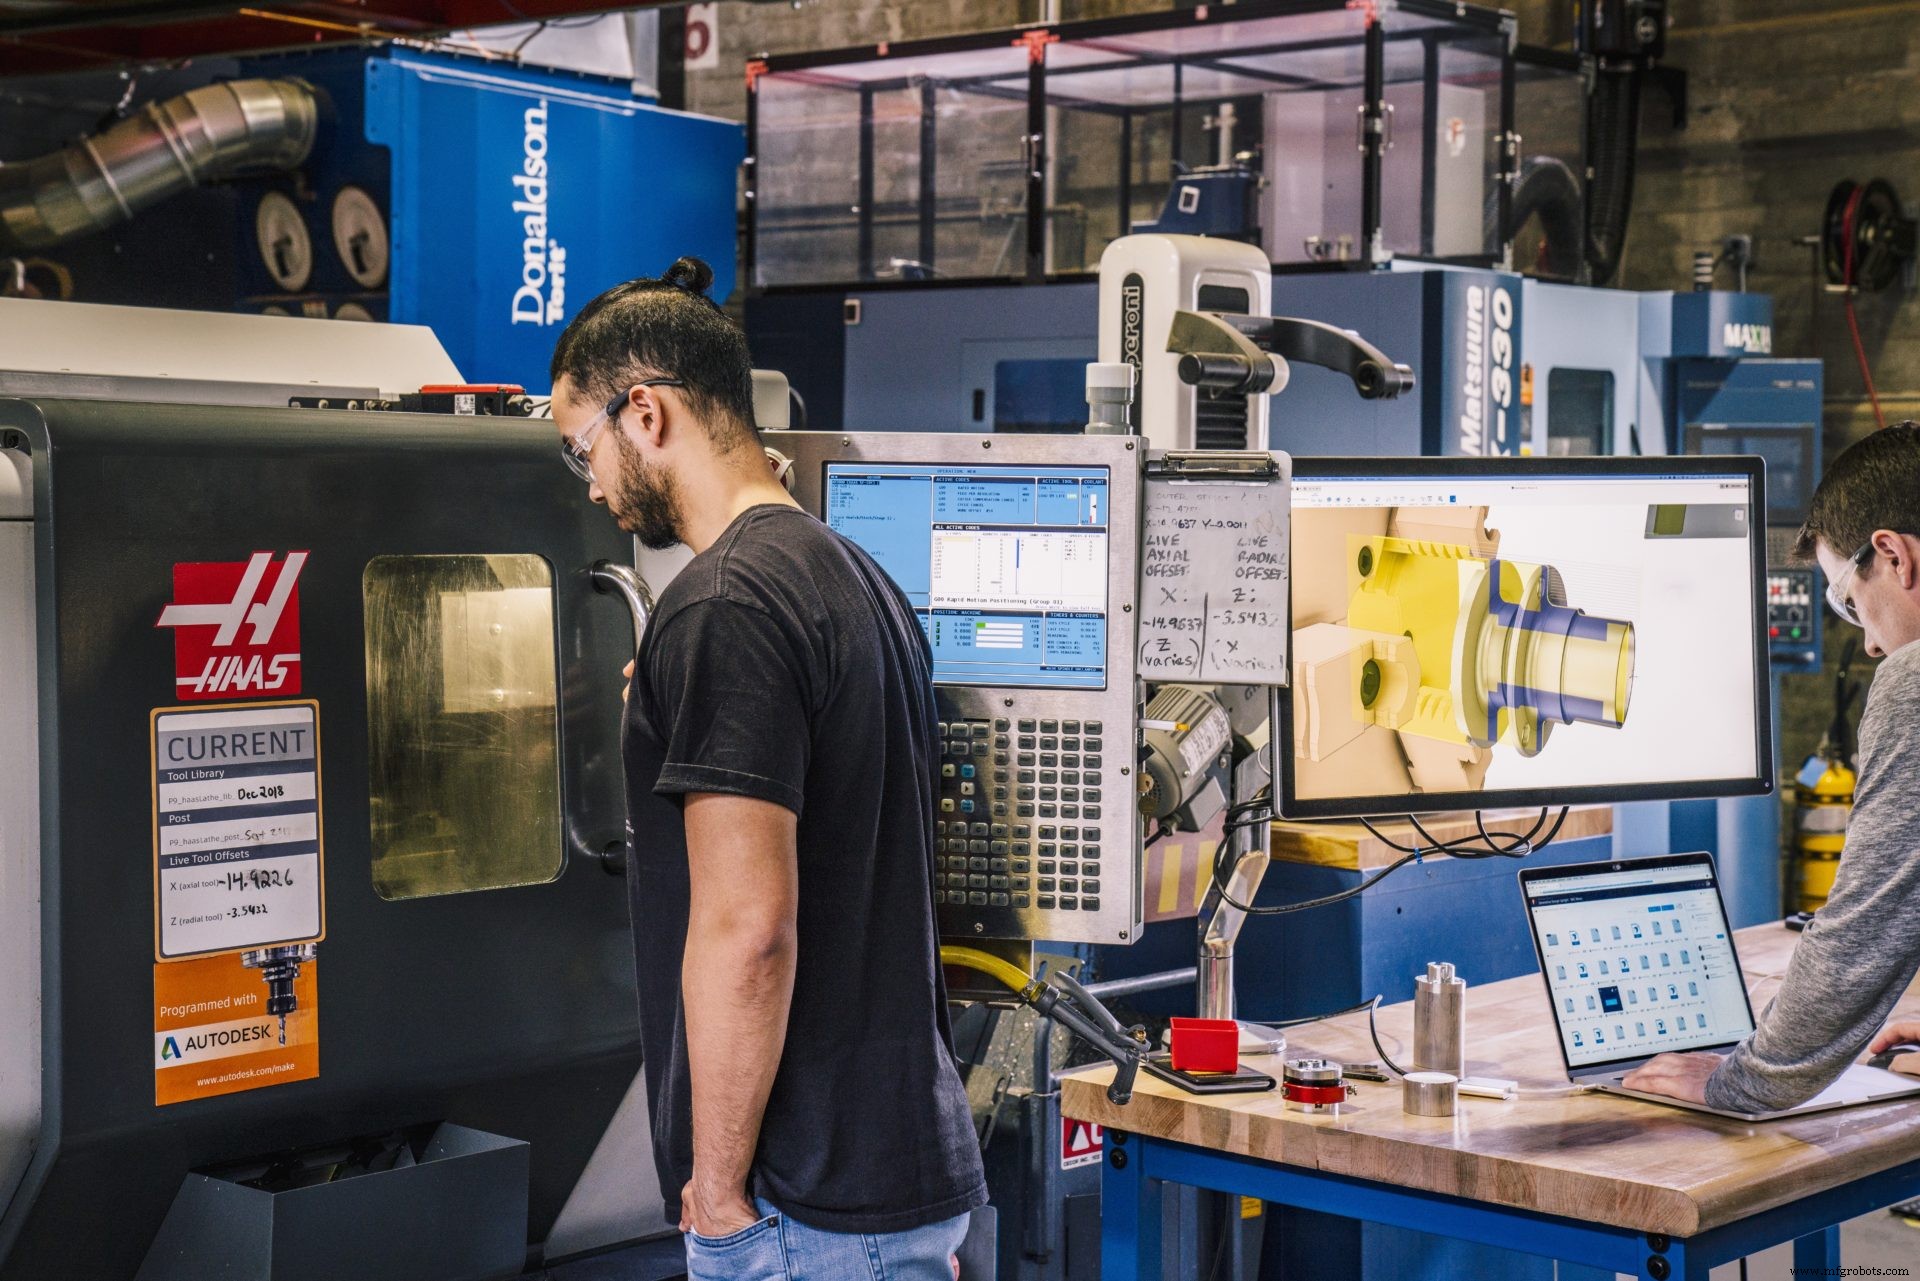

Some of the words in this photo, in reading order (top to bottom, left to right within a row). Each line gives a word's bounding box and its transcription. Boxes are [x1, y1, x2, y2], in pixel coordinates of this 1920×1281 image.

[1145, 534, 1180, 546] LIVE
[1146, 548, 1190, 562] AXIAL
[176, 653, 301, 693] HAAS
[167, 729, 306, 762] CURRENT
[167, 771, 188, 781] Tool
[191, 769, 225, 780] Library
[237, 788, 259, 801] Dec
[259, 785, 285, 798] 2018
[168, 813, 191, 824] Post
[169, 856, 190, 866] Live
[191, 854, 213, 864] Tool
[215, 850, 250, 861] Offsets
[170, 882, 177, 891] X
[179, 880, 200, 890] (axial
[201, 878, 219, 889] tool)
[170, 917, 177, 926] Z
[179, 915, 203, 926] (radial
[205, 913, 223, 923] tool)
[160, 996, 231, 1018] Programmed
[233, 992, 257, 1007] with
[185, 1023, 272, 1052] AUTODESK
[196, 1062, 295, 1087] www.autodesk.com/make
